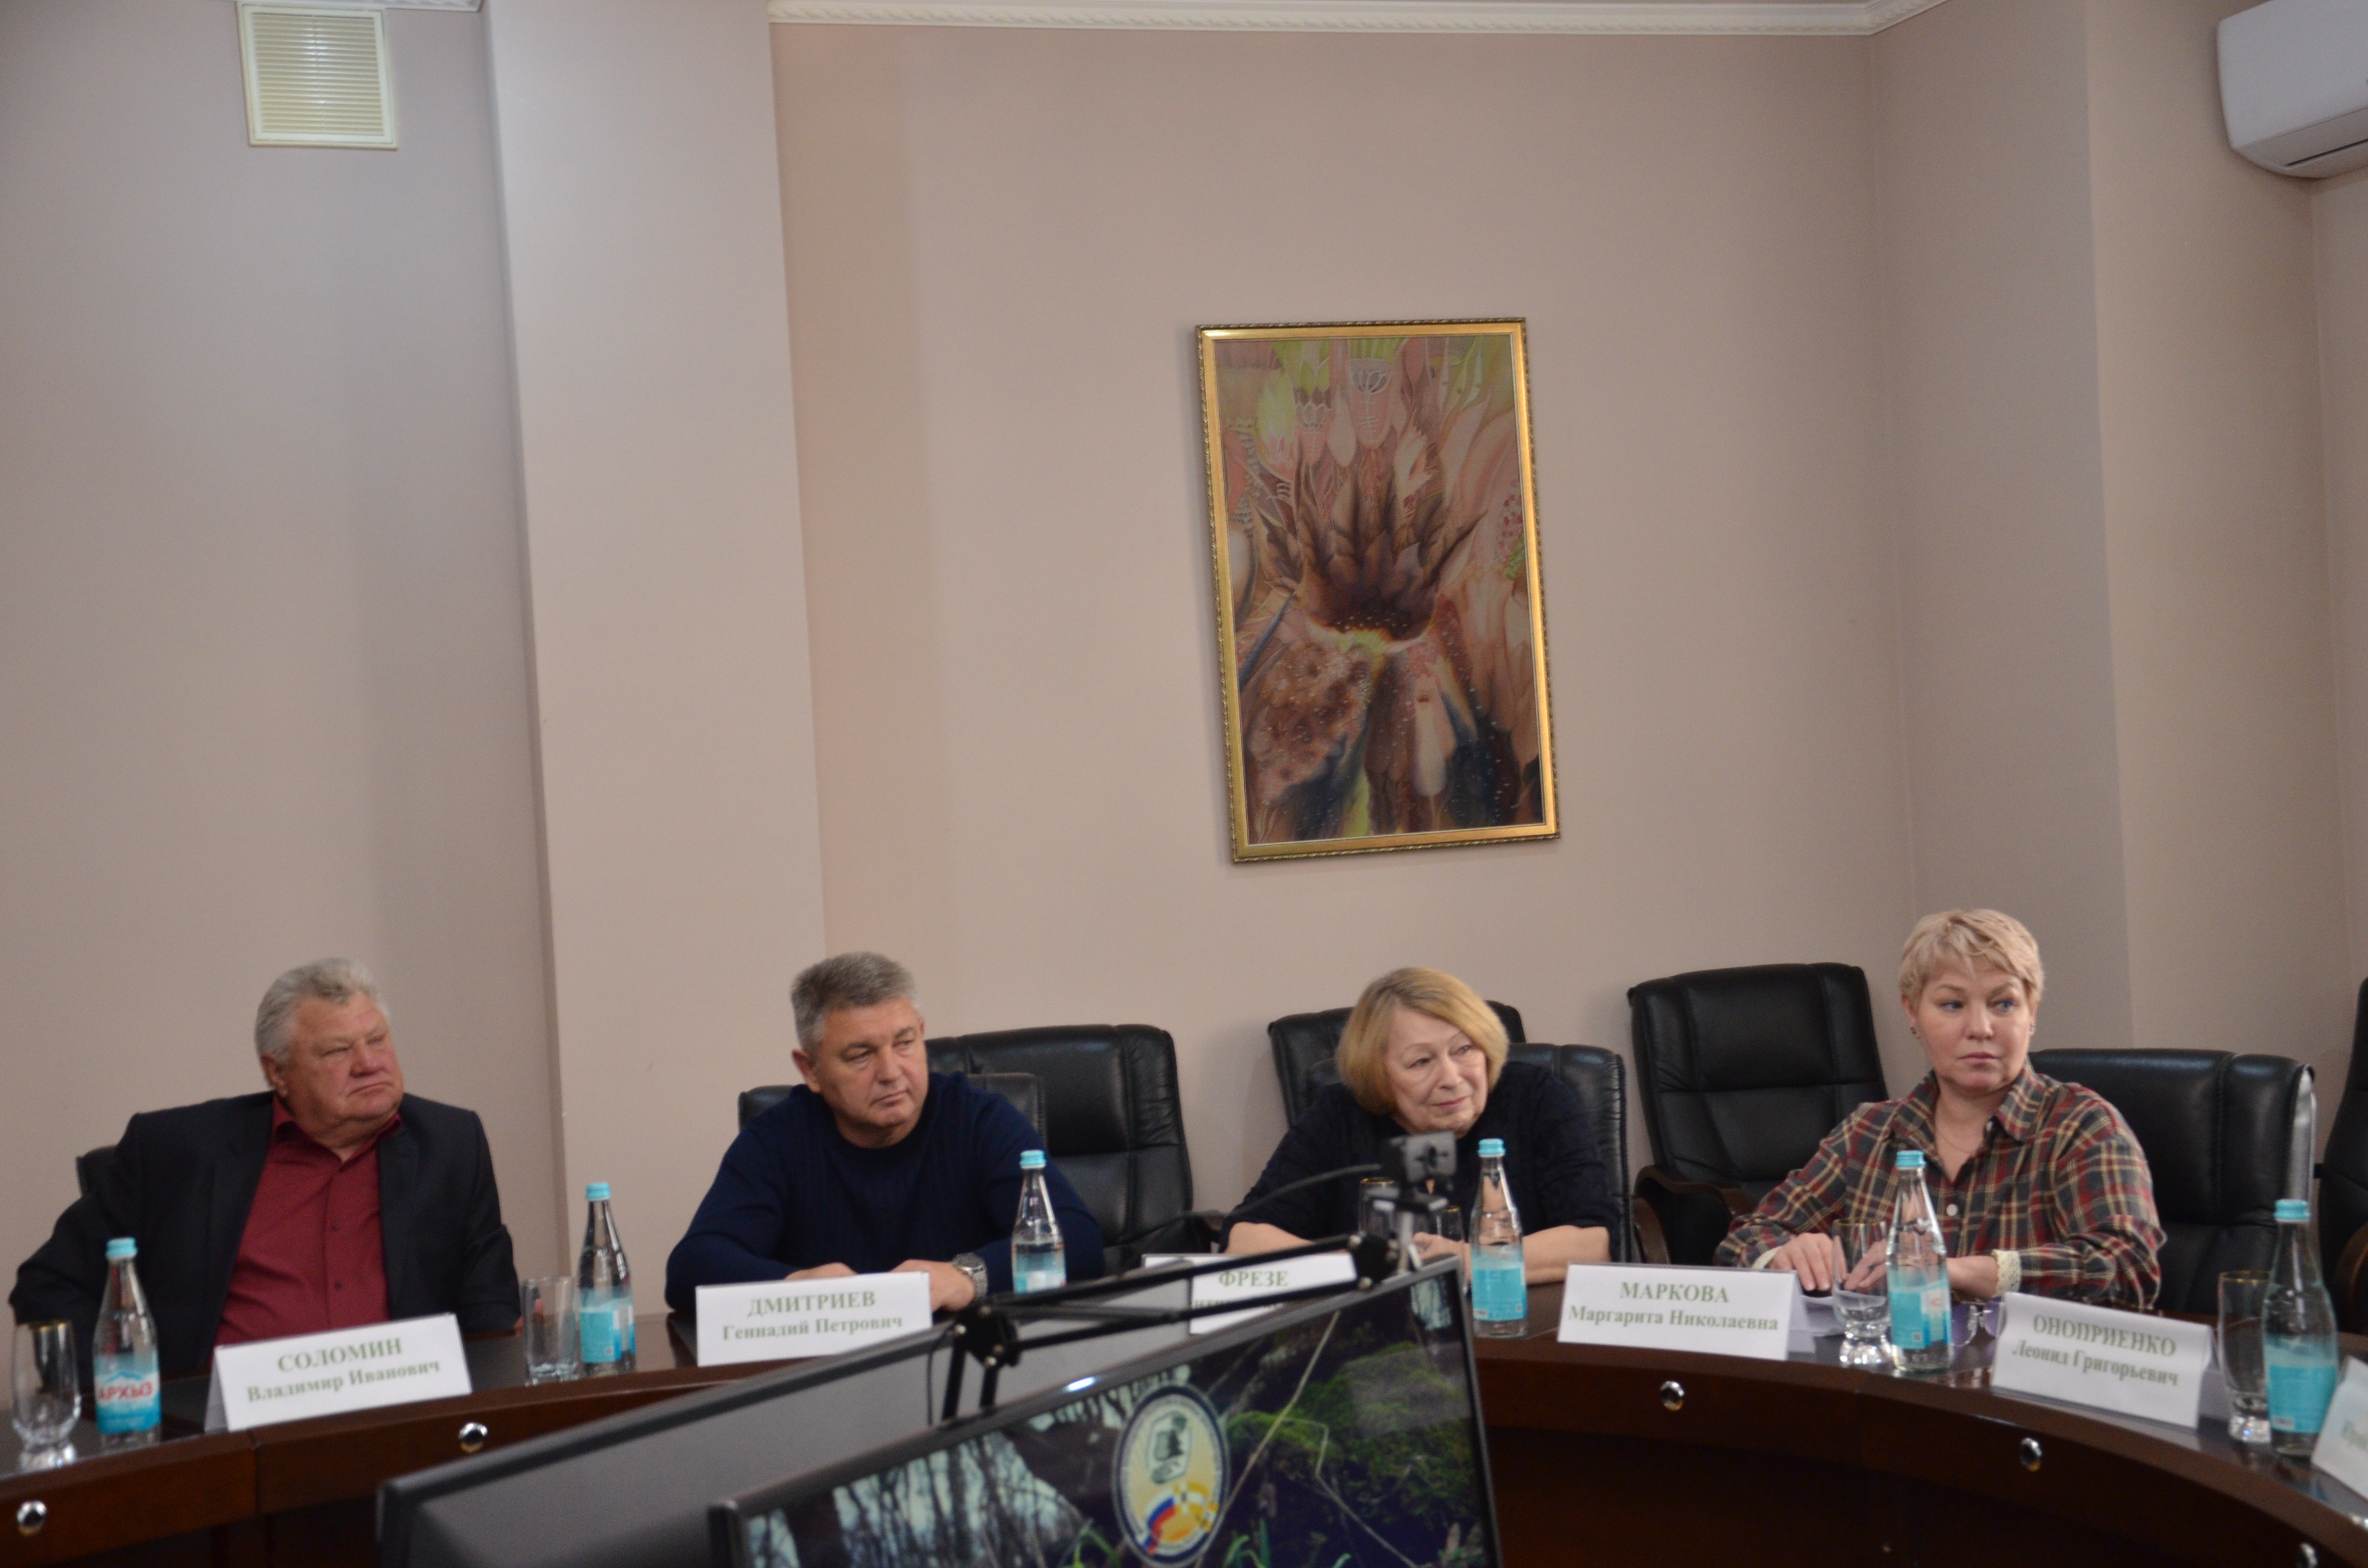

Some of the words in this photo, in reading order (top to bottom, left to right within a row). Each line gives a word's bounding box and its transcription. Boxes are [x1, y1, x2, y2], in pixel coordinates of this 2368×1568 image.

[1218, 1270, 1288, 1286] ФРЕЗЕ
[747, 1290, 876, 1318] ДМИТРИЕВ
[1620, 1282, 1730, 1303] МАРКОВА
[723, 1321, 809, 1340] Геннадий
[815, 1316, 903, 1334] Петрович
[1569, 1305, 1663, 1327] Маргарита
[1668, 1310, 1779, 1330] Николаевна
[2032, 1314, 2177, 1357] ОНОПРИЕНКО
[277, 1337, 402, 1372] СОЛОМИН
[2012, 1339, 2069, 1366] Леонид
[2073, 1350, 2178, 1385] Григорьевич
[98, 1381, 153, 1401] АРХЫЗ
[247, 1376, 343, 1402] Владимир
[348, 1360, 441, 1385] Иванович
